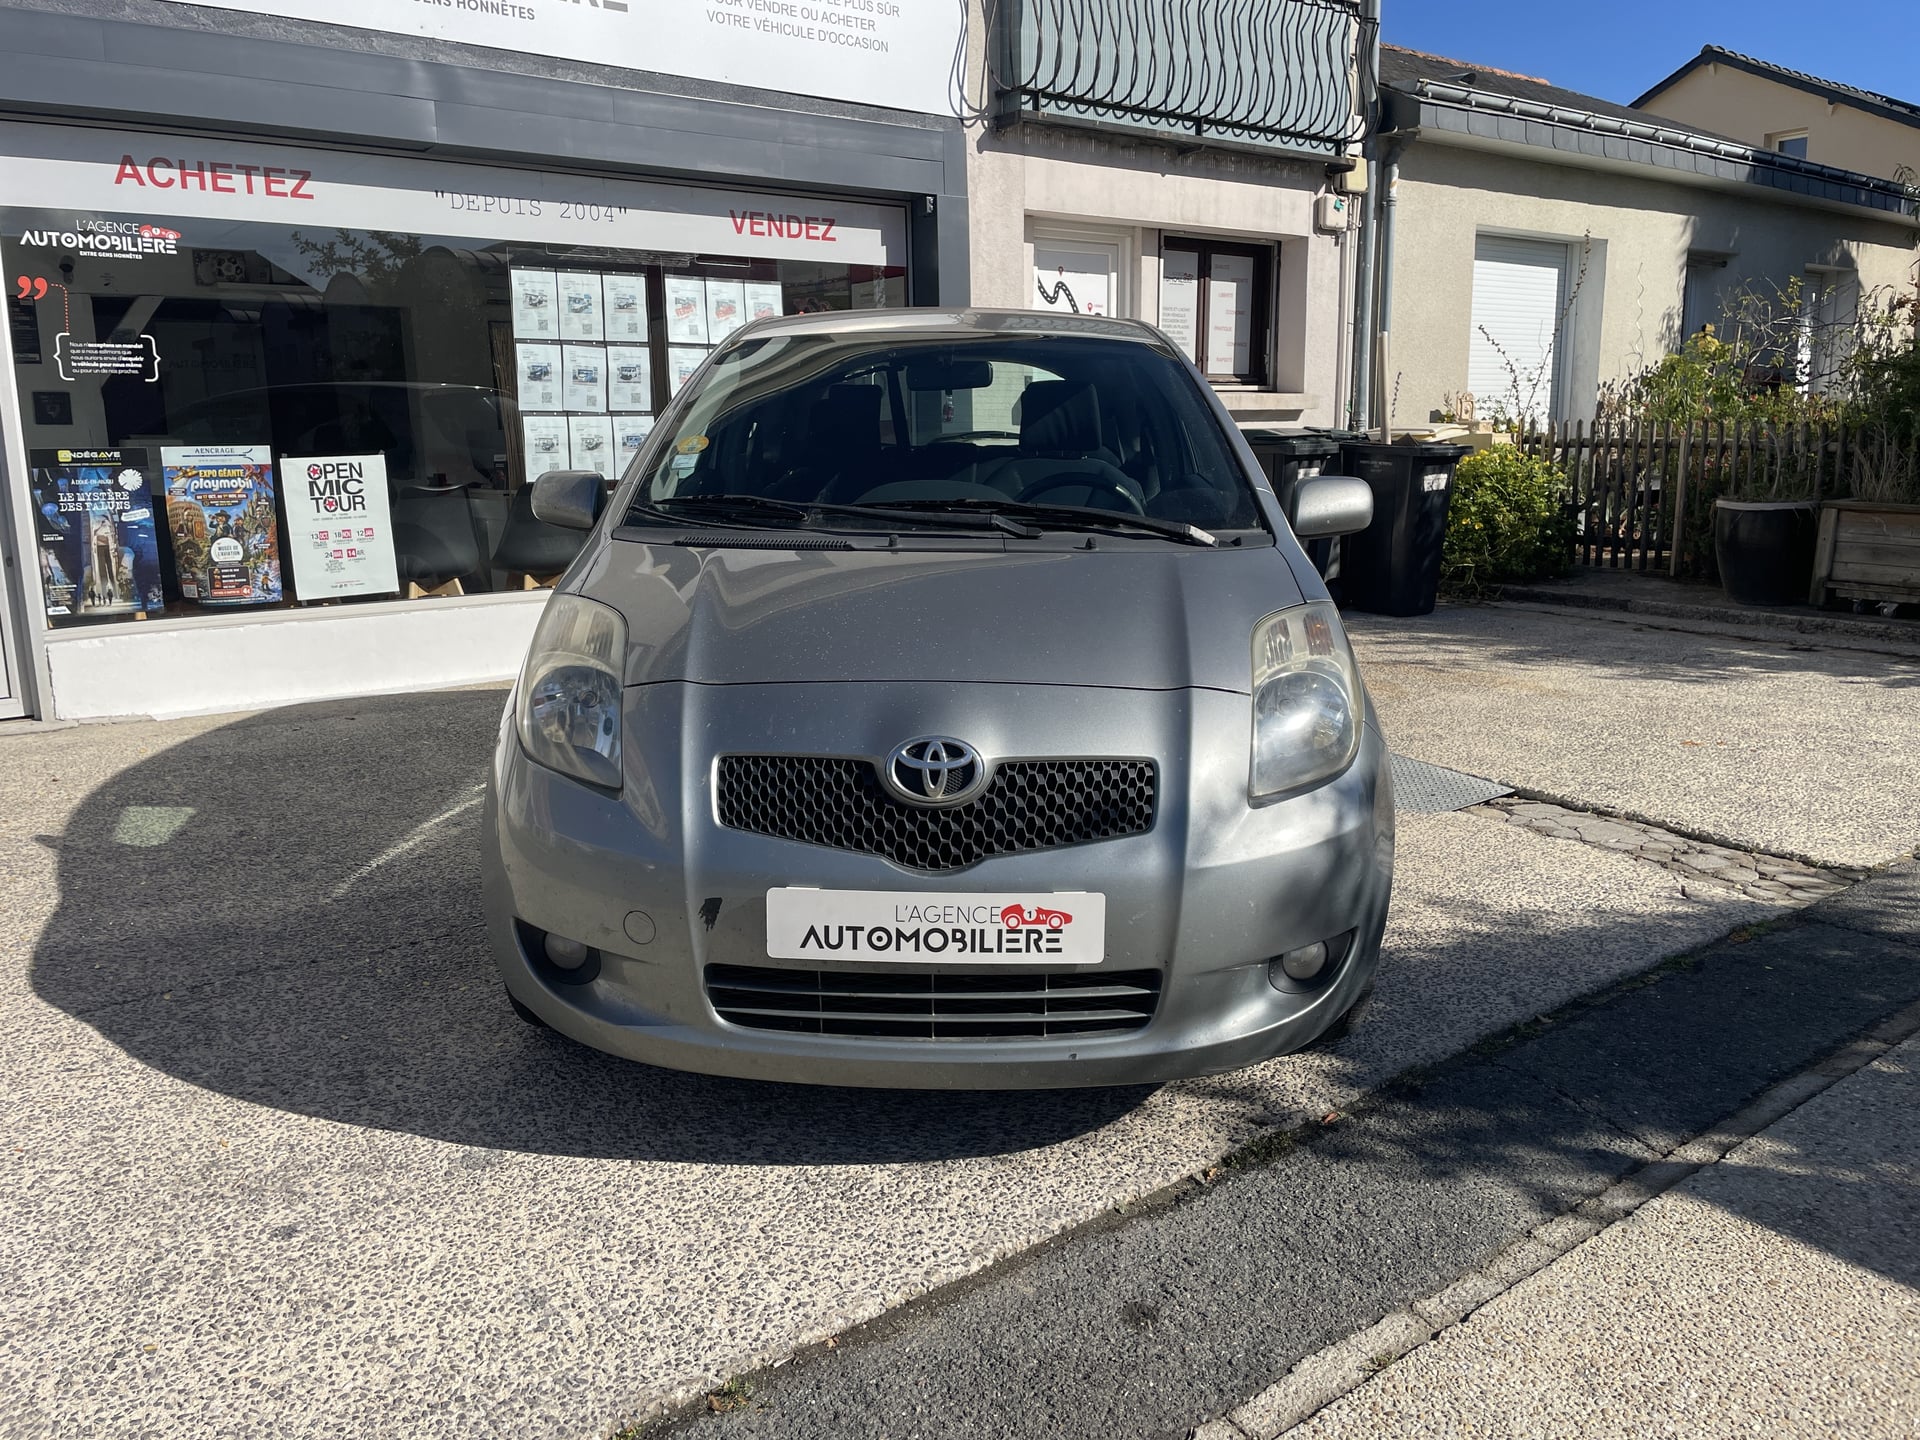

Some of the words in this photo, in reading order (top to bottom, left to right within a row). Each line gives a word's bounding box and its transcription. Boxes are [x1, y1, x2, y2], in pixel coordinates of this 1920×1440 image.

[747, 0, 798, 18] VENDRE
[800, 7, 819, 21] OU
[821, 11, 876, 31] ACHETER
[877, 1, 900, 17] SÛR
[706, 9, 750, 29] VOTRE
[754, 17, 815, 40] VÉHICULE
[818, 29, 889, 53] D'OCCASION
[114, 154, 315, 200] ACHETEZ
[434, 189, 542, 217] "DEPUIS
[559, 200, 627, 222] 2004"
[76, 219, 140, 235] L'AGENCE
[729, 209, 837, 242] VENDEZ
[199, 469, 217, 478] EXPO
[218, 468, 245, 477] GÉANTE
[307, 462, 363, 480] OPEN
[190, 477, 254, 492] playmobil
[308, 479, 364, 496] MIC
[58, 492, 75, 502] LE
[76, 489, 130, 501] MYSTÈRE
[310, 495, 366, 513] TOUR
[59, 503, 83, 513] DES
[85, 501, 131, 511] FALUNS
[895, 905, 1001, 925] L'AGENCE
